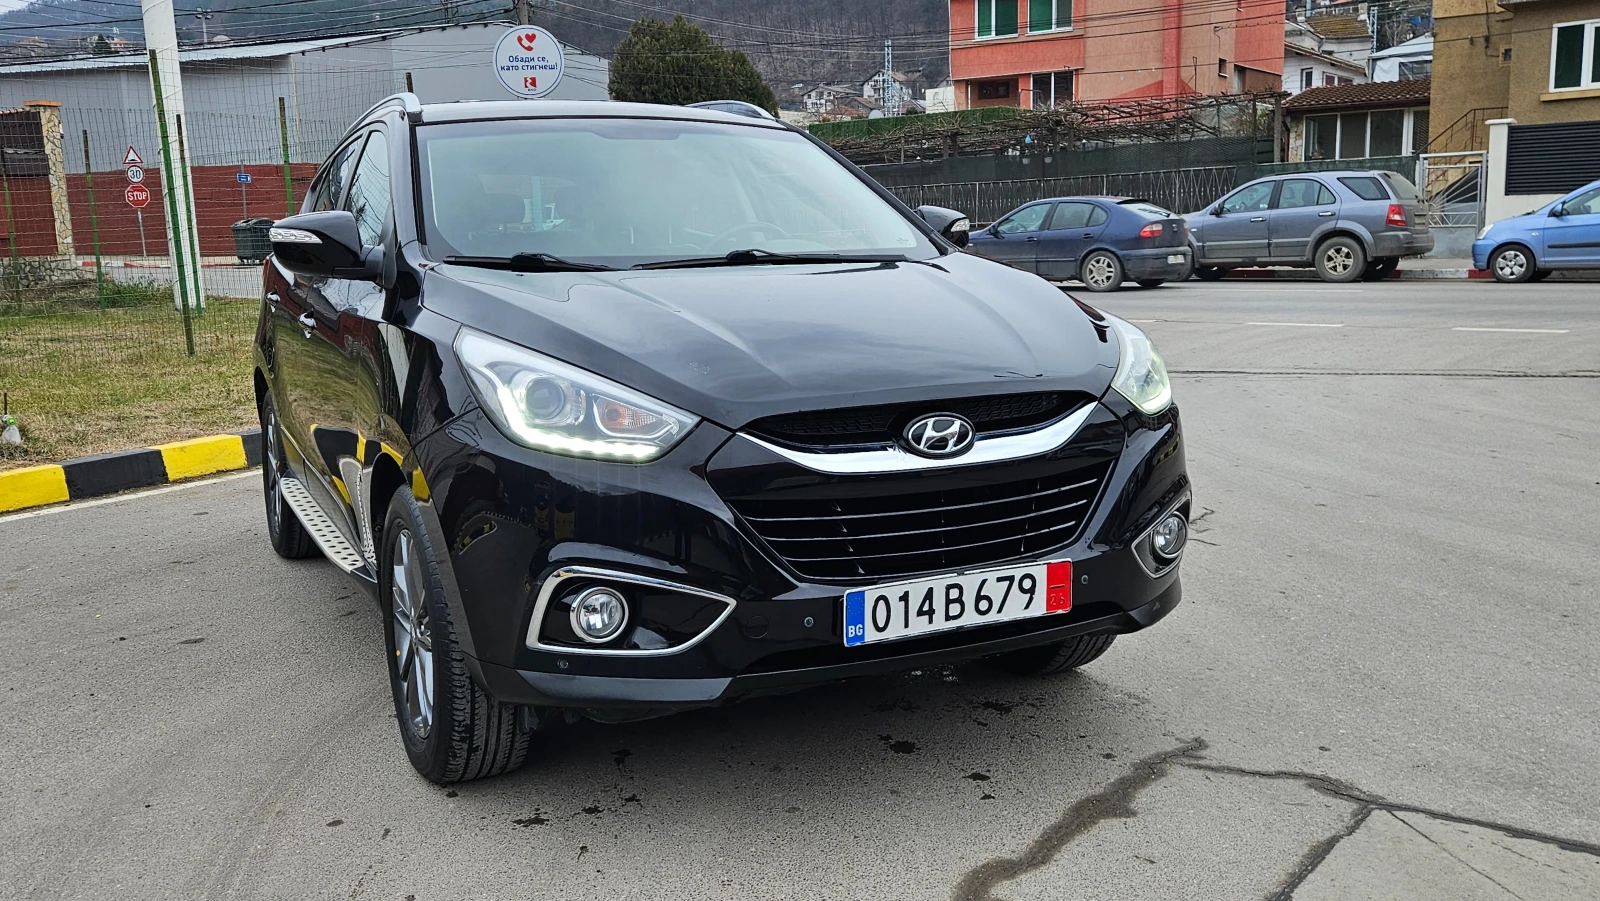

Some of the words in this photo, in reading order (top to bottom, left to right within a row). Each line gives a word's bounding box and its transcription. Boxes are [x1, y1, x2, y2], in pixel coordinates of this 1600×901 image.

[508, 56, 534, 64] Обади
[522, 62, 558, 70] стигнеш!
[130, 170, 141, 179] 30
[128, 192, 147, 200] STOP
[871, 572, 1038, 633] 014B679
[848, 624, 864, 638] BG
